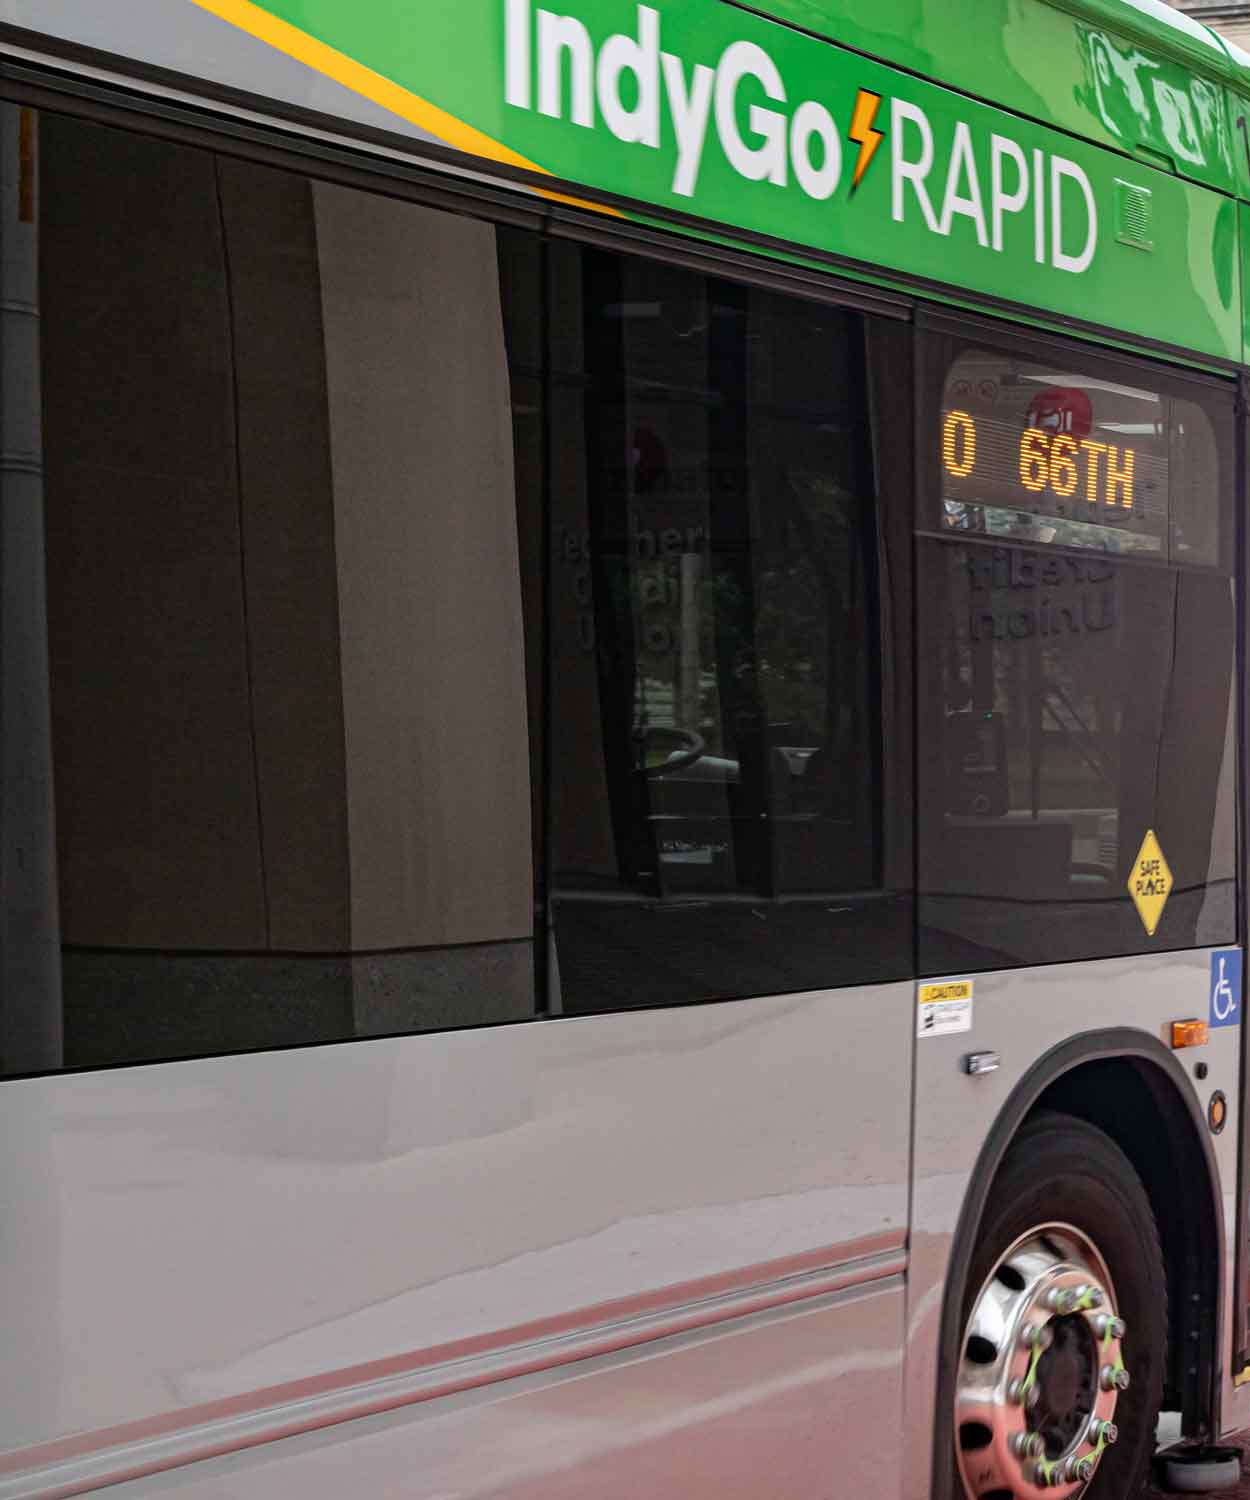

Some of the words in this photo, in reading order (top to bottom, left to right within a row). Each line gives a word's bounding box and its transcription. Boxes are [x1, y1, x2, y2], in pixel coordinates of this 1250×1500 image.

[504, 0, 843, 201] IndyGo
[890, 96, 1098, 274] RAPID
[1019, 427, 1136, 509] 66TH
[1139, 859, 1161, 877] SAFE
